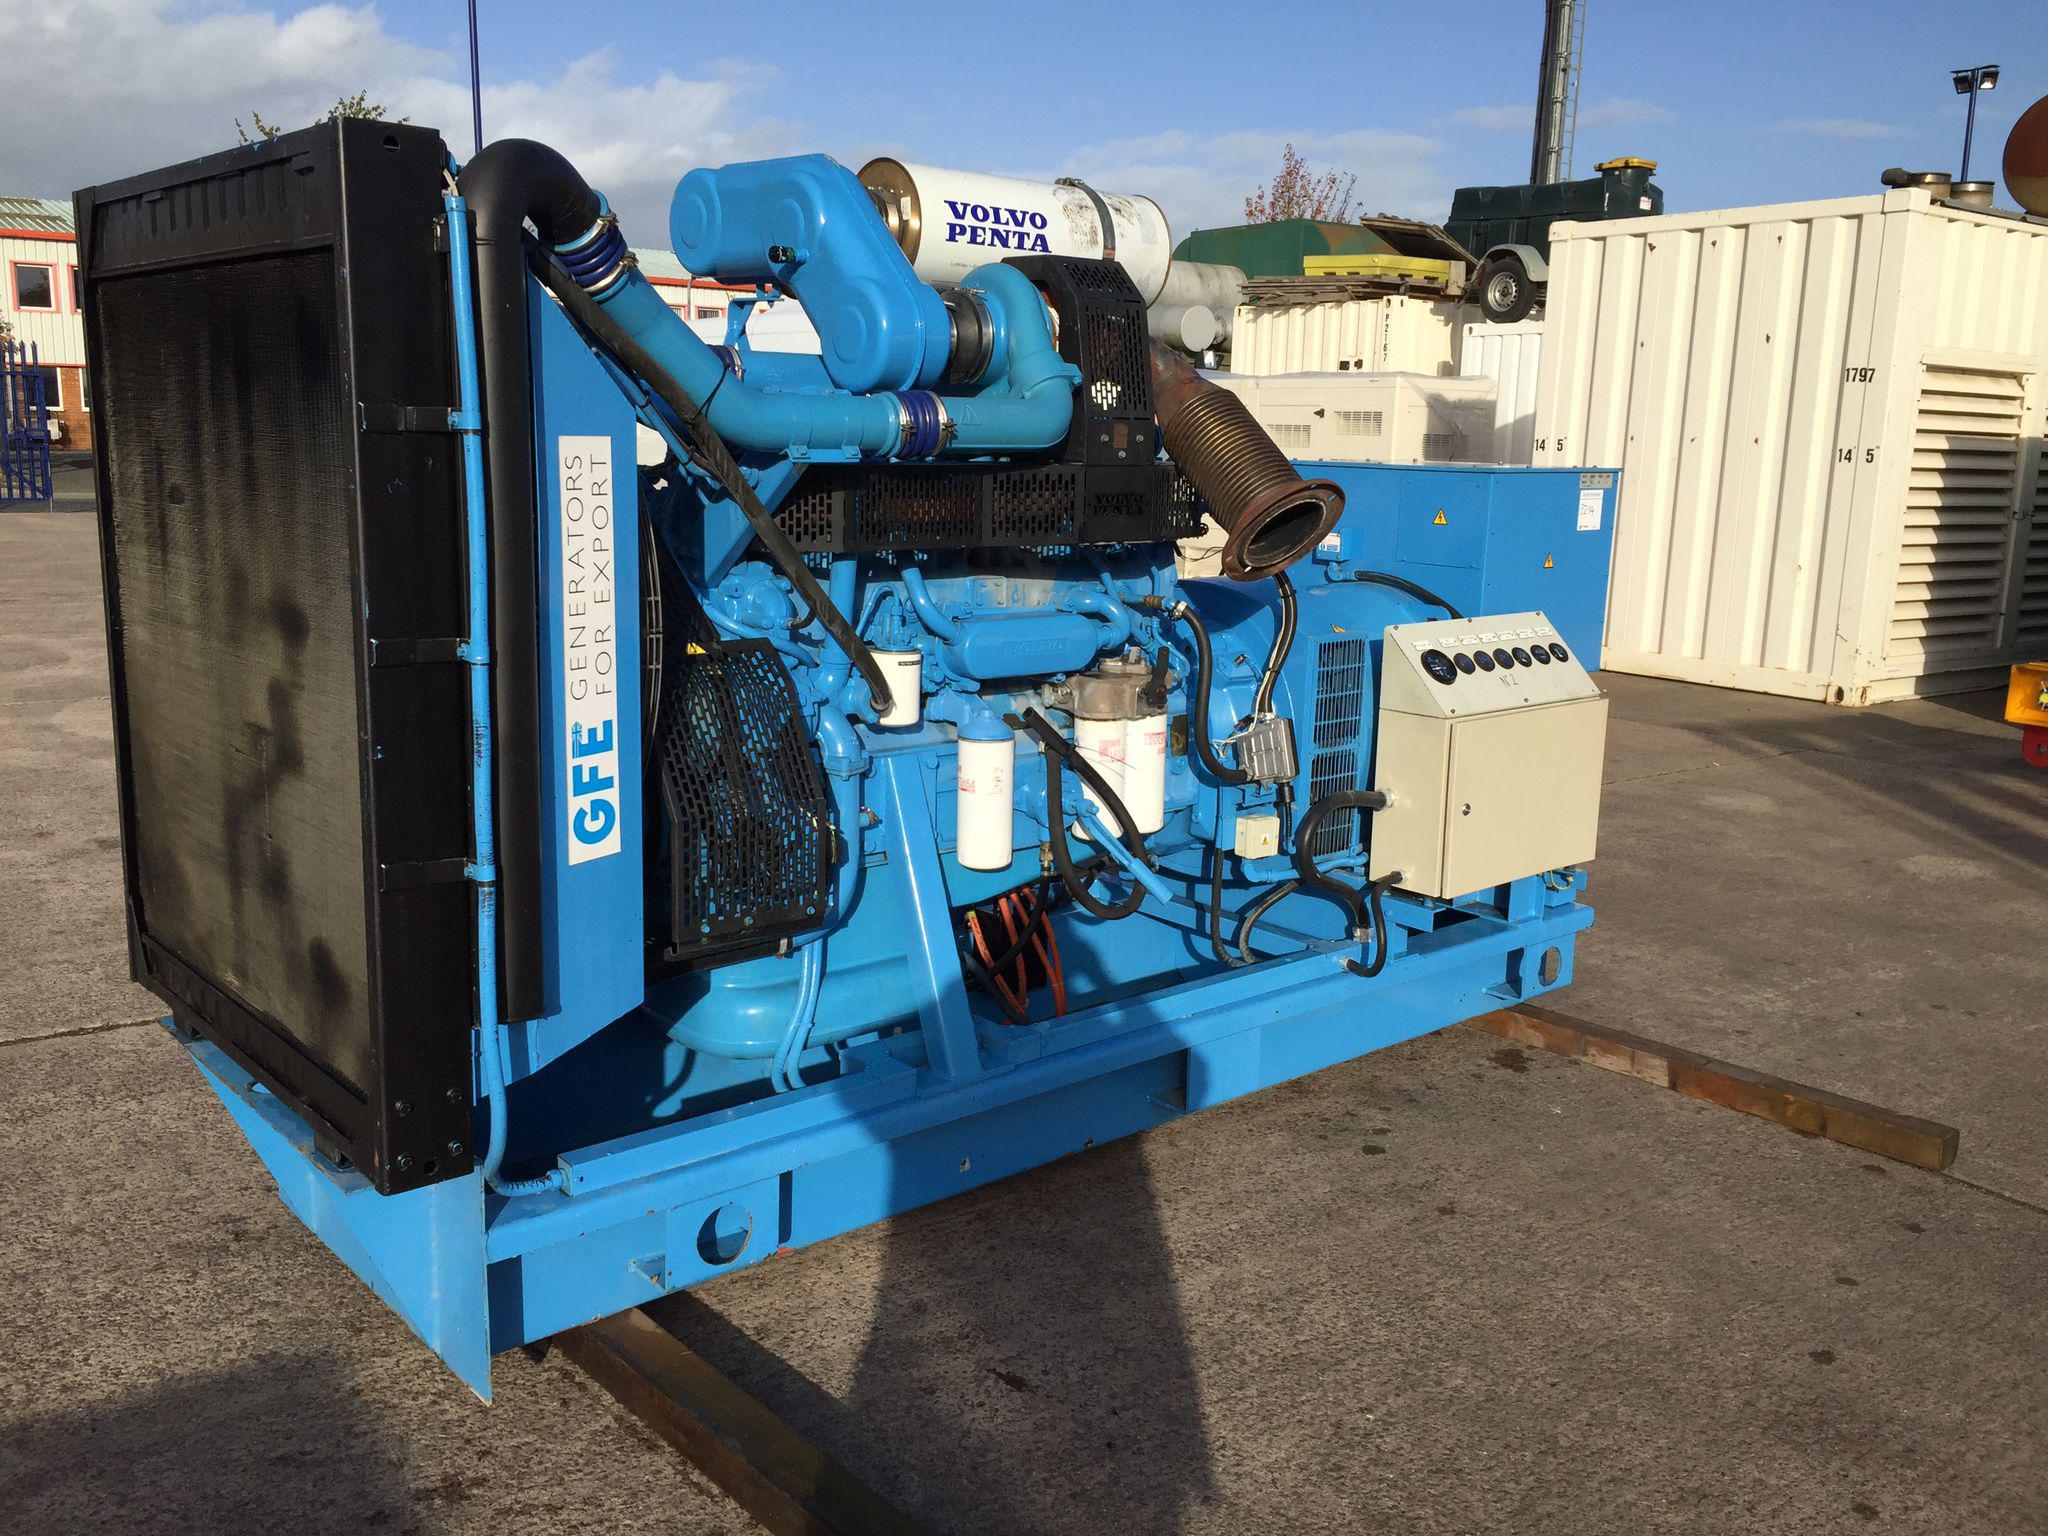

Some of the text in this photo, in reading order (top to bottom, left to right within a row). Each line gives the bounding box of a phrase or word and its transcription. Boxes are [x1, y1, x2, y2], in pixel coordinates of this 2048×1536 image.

[943, 199, 1048, 230] VOLVO
[945, 222, 1052, 253] PENTA
[1845, 367, 1876, 383] 1797
[564, 455, 588, 701] GENERATORS
[589, 453, 612, 696] FOR EXPORT
[571, 719, 616, 845] GFE
